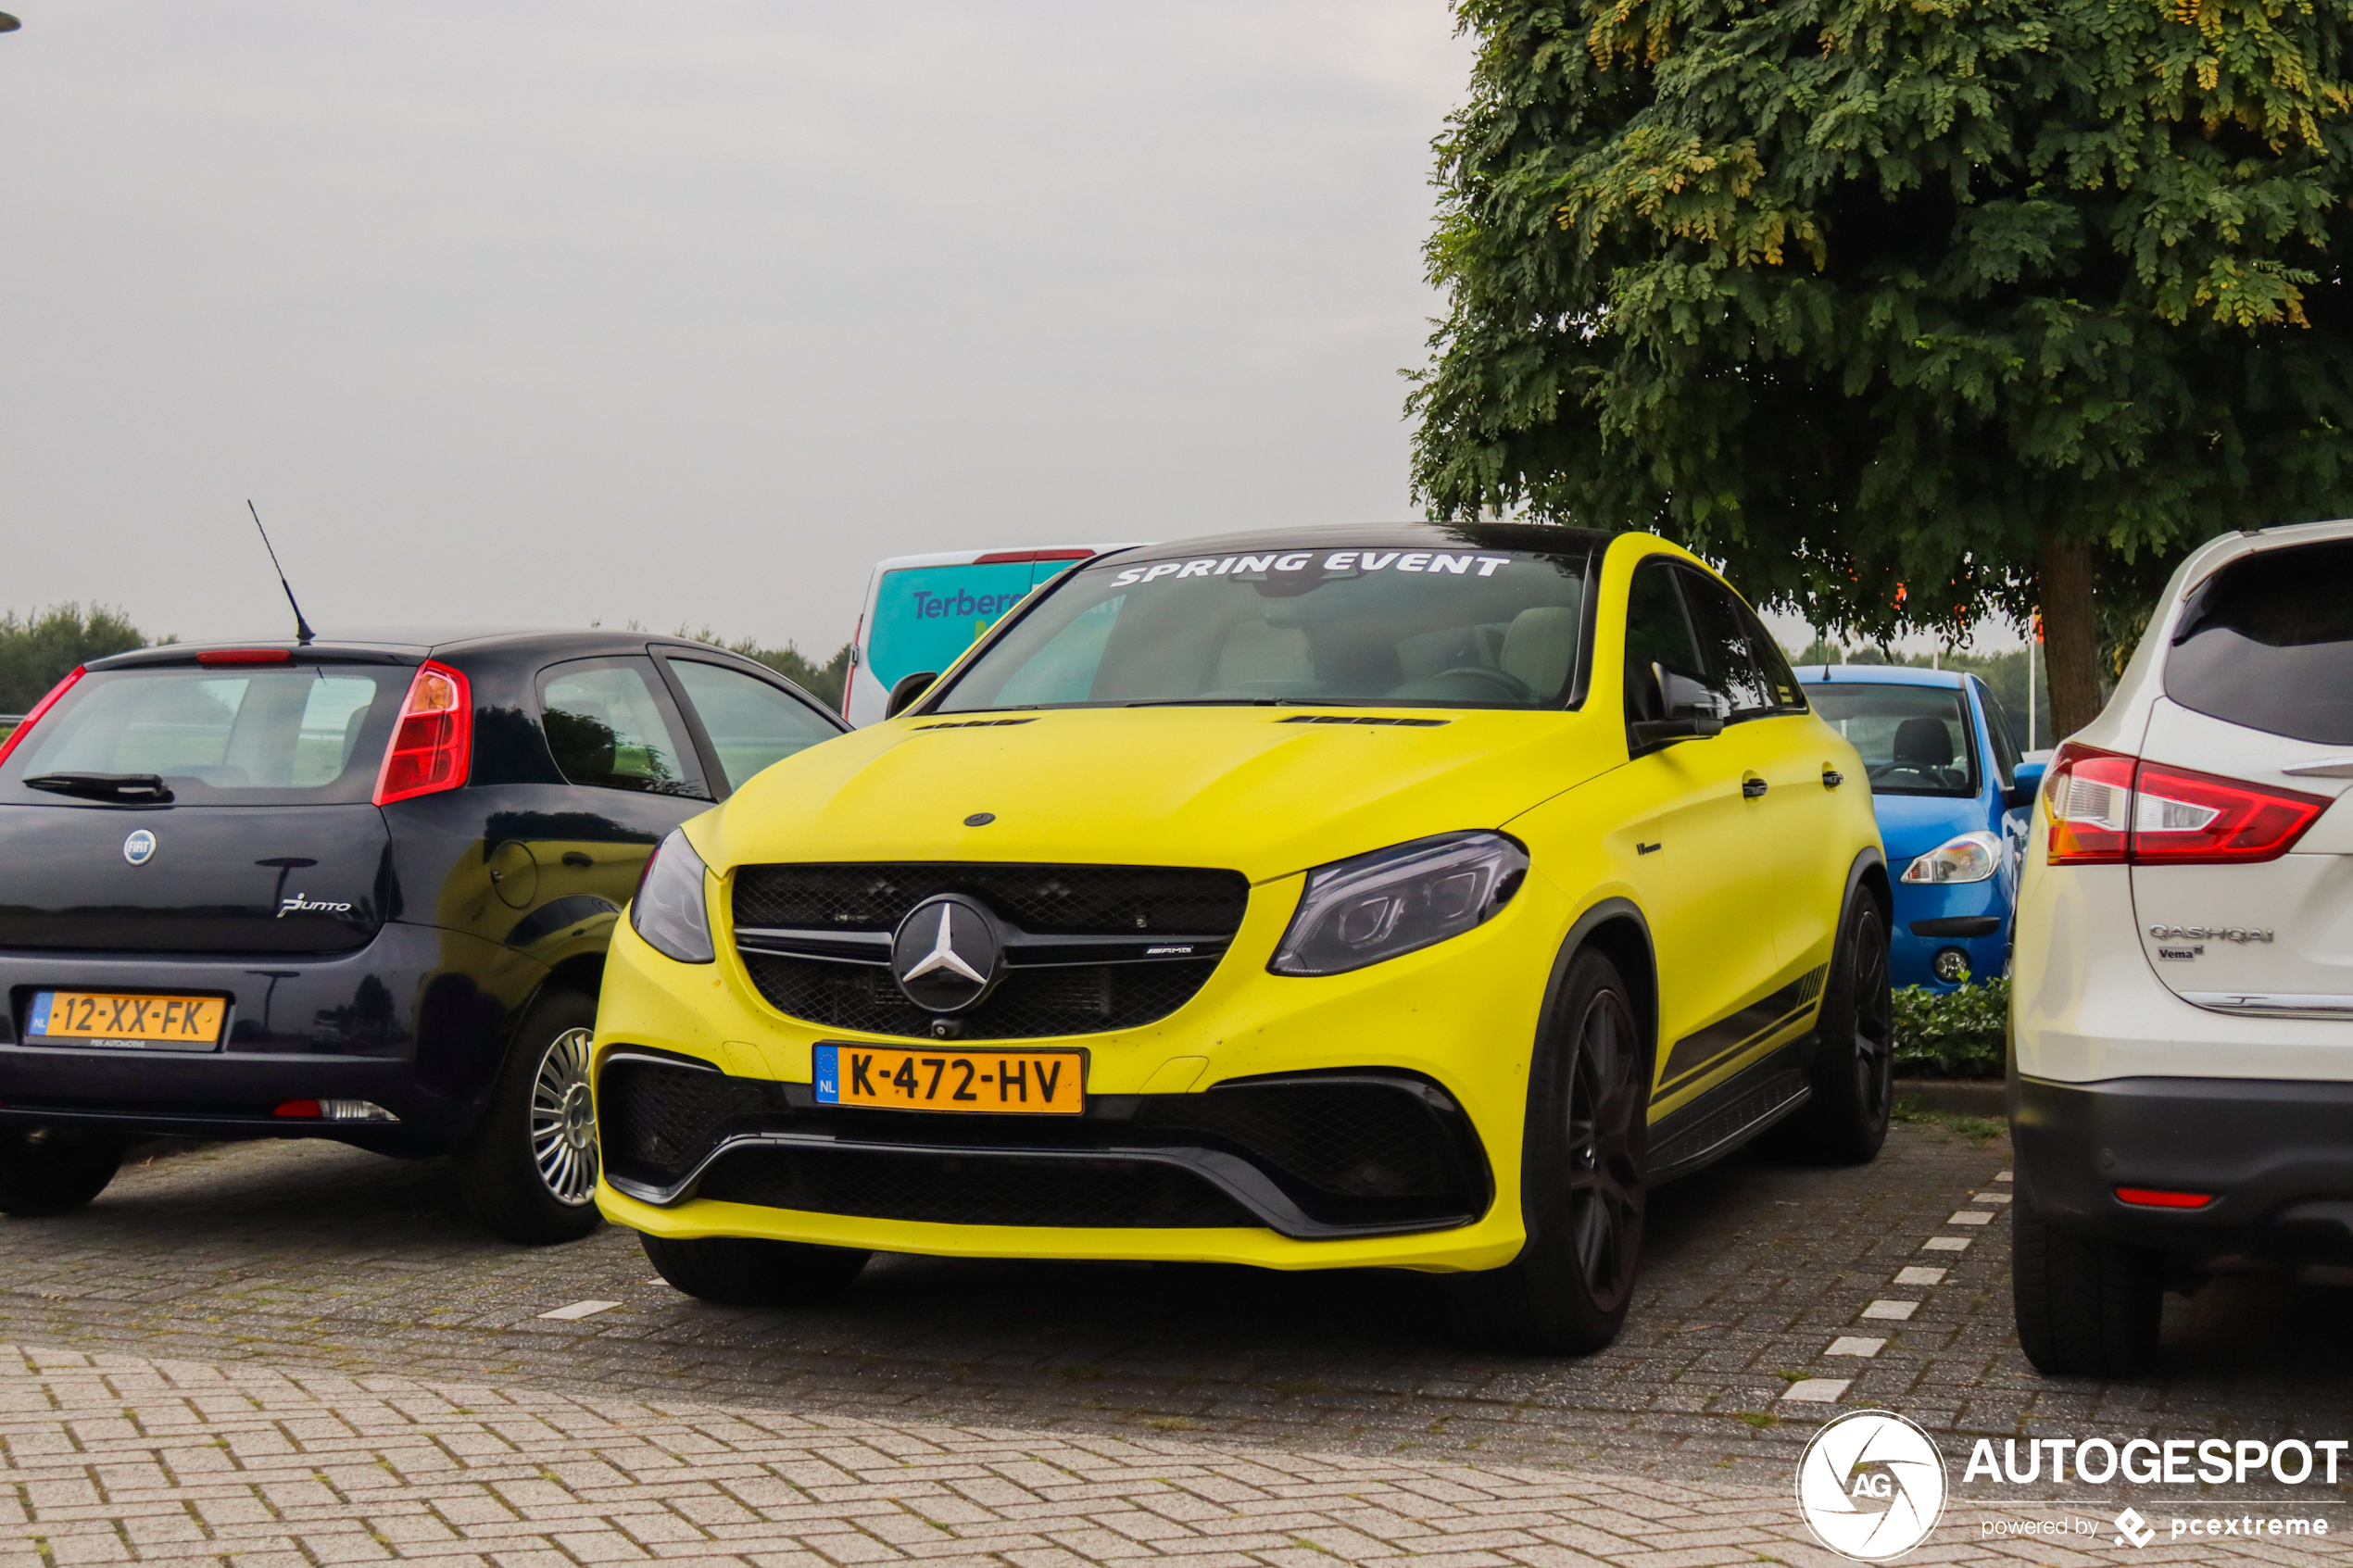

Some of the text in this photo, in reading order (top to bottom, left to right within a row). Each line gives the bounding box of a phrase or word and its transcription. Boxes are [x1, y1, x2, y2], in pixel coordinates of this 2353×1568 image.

[1110, 552, 1511, 588] SPRING EVENT
[128, 840, 151, 853] FIAT
[2149, 923, 2275, 944] QASHQAI
[2158, 948, 2194, 959] Vema
[32, 1017, 47, 1029] NL
[65, 997, 203, 1035] 12-XX-FK
[105, 1040, 146, 1048] AUTOMOTIVE
[851, 1053, 1062, 1103] K-472-HV
[819, 1079, 837, 1095] NL
